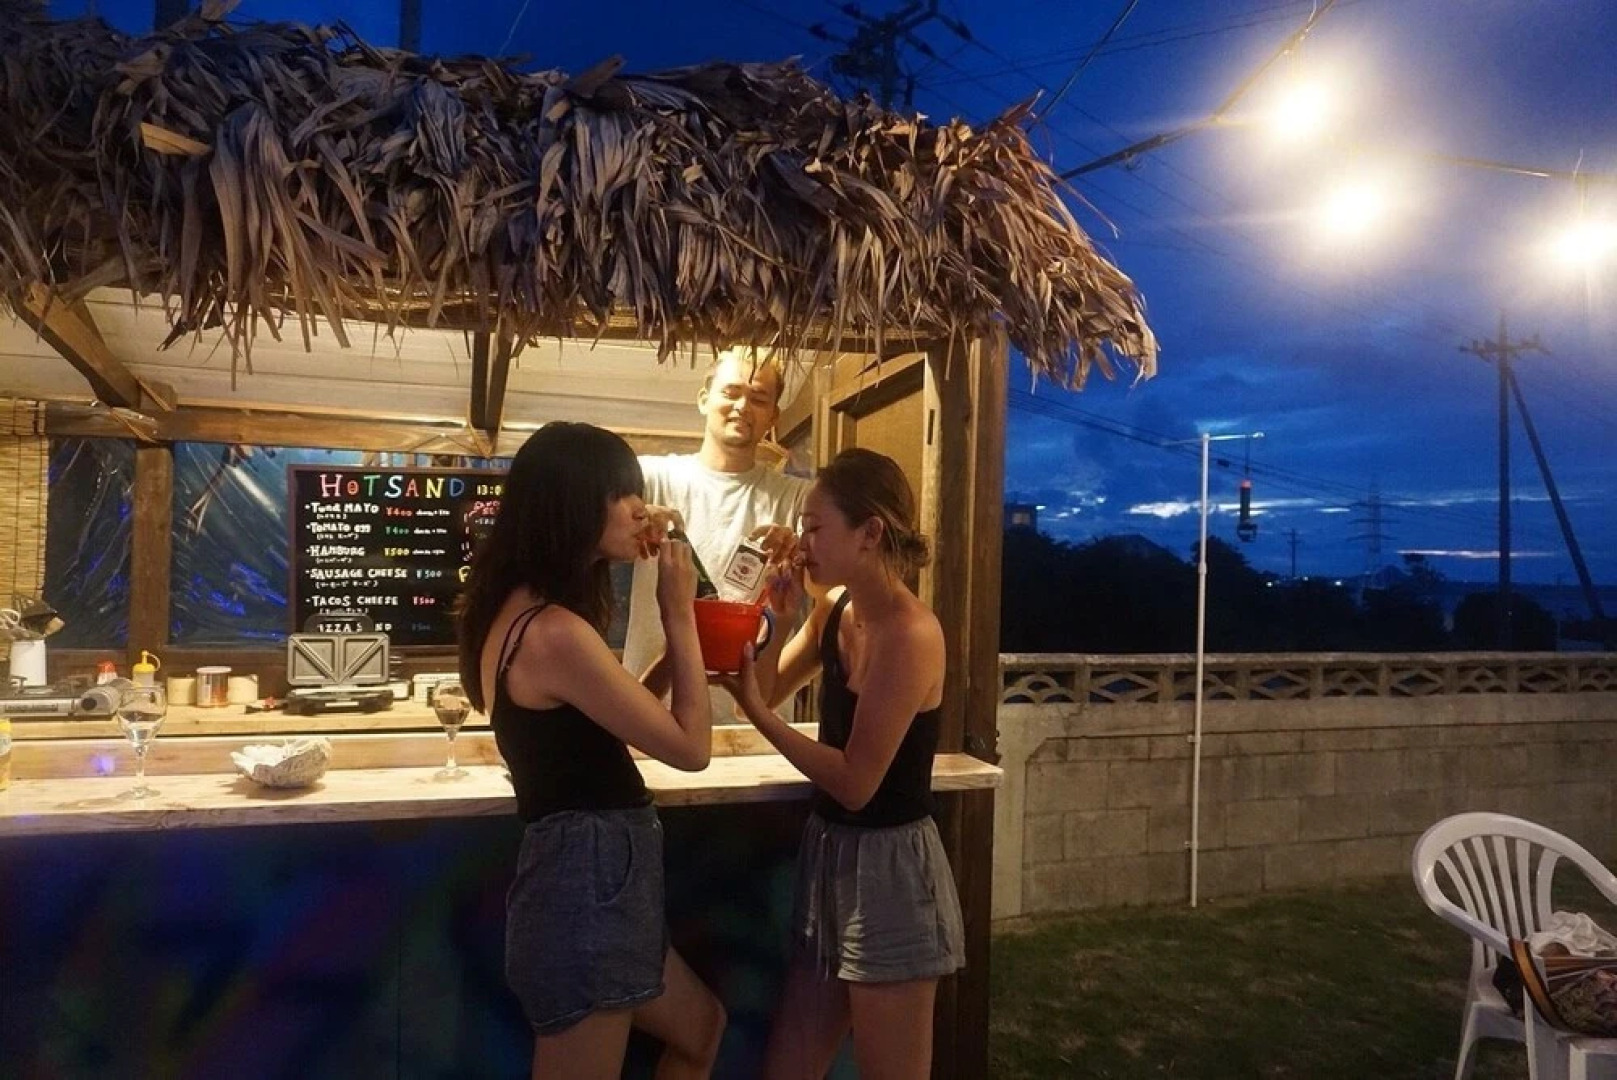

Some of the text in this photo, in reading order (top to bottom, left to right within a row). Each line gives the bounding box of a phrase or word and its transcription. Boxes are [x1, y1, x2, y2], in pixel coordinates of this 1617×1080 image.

[343, 502, 380, 514] MAYO
[310, 544, 365, 557] HAMBURG
[310, 568, 363, 580] SAUSAGE
[367, 568, 408, 579] CHEESE
[357, 596, 399, 606] CHEESE
